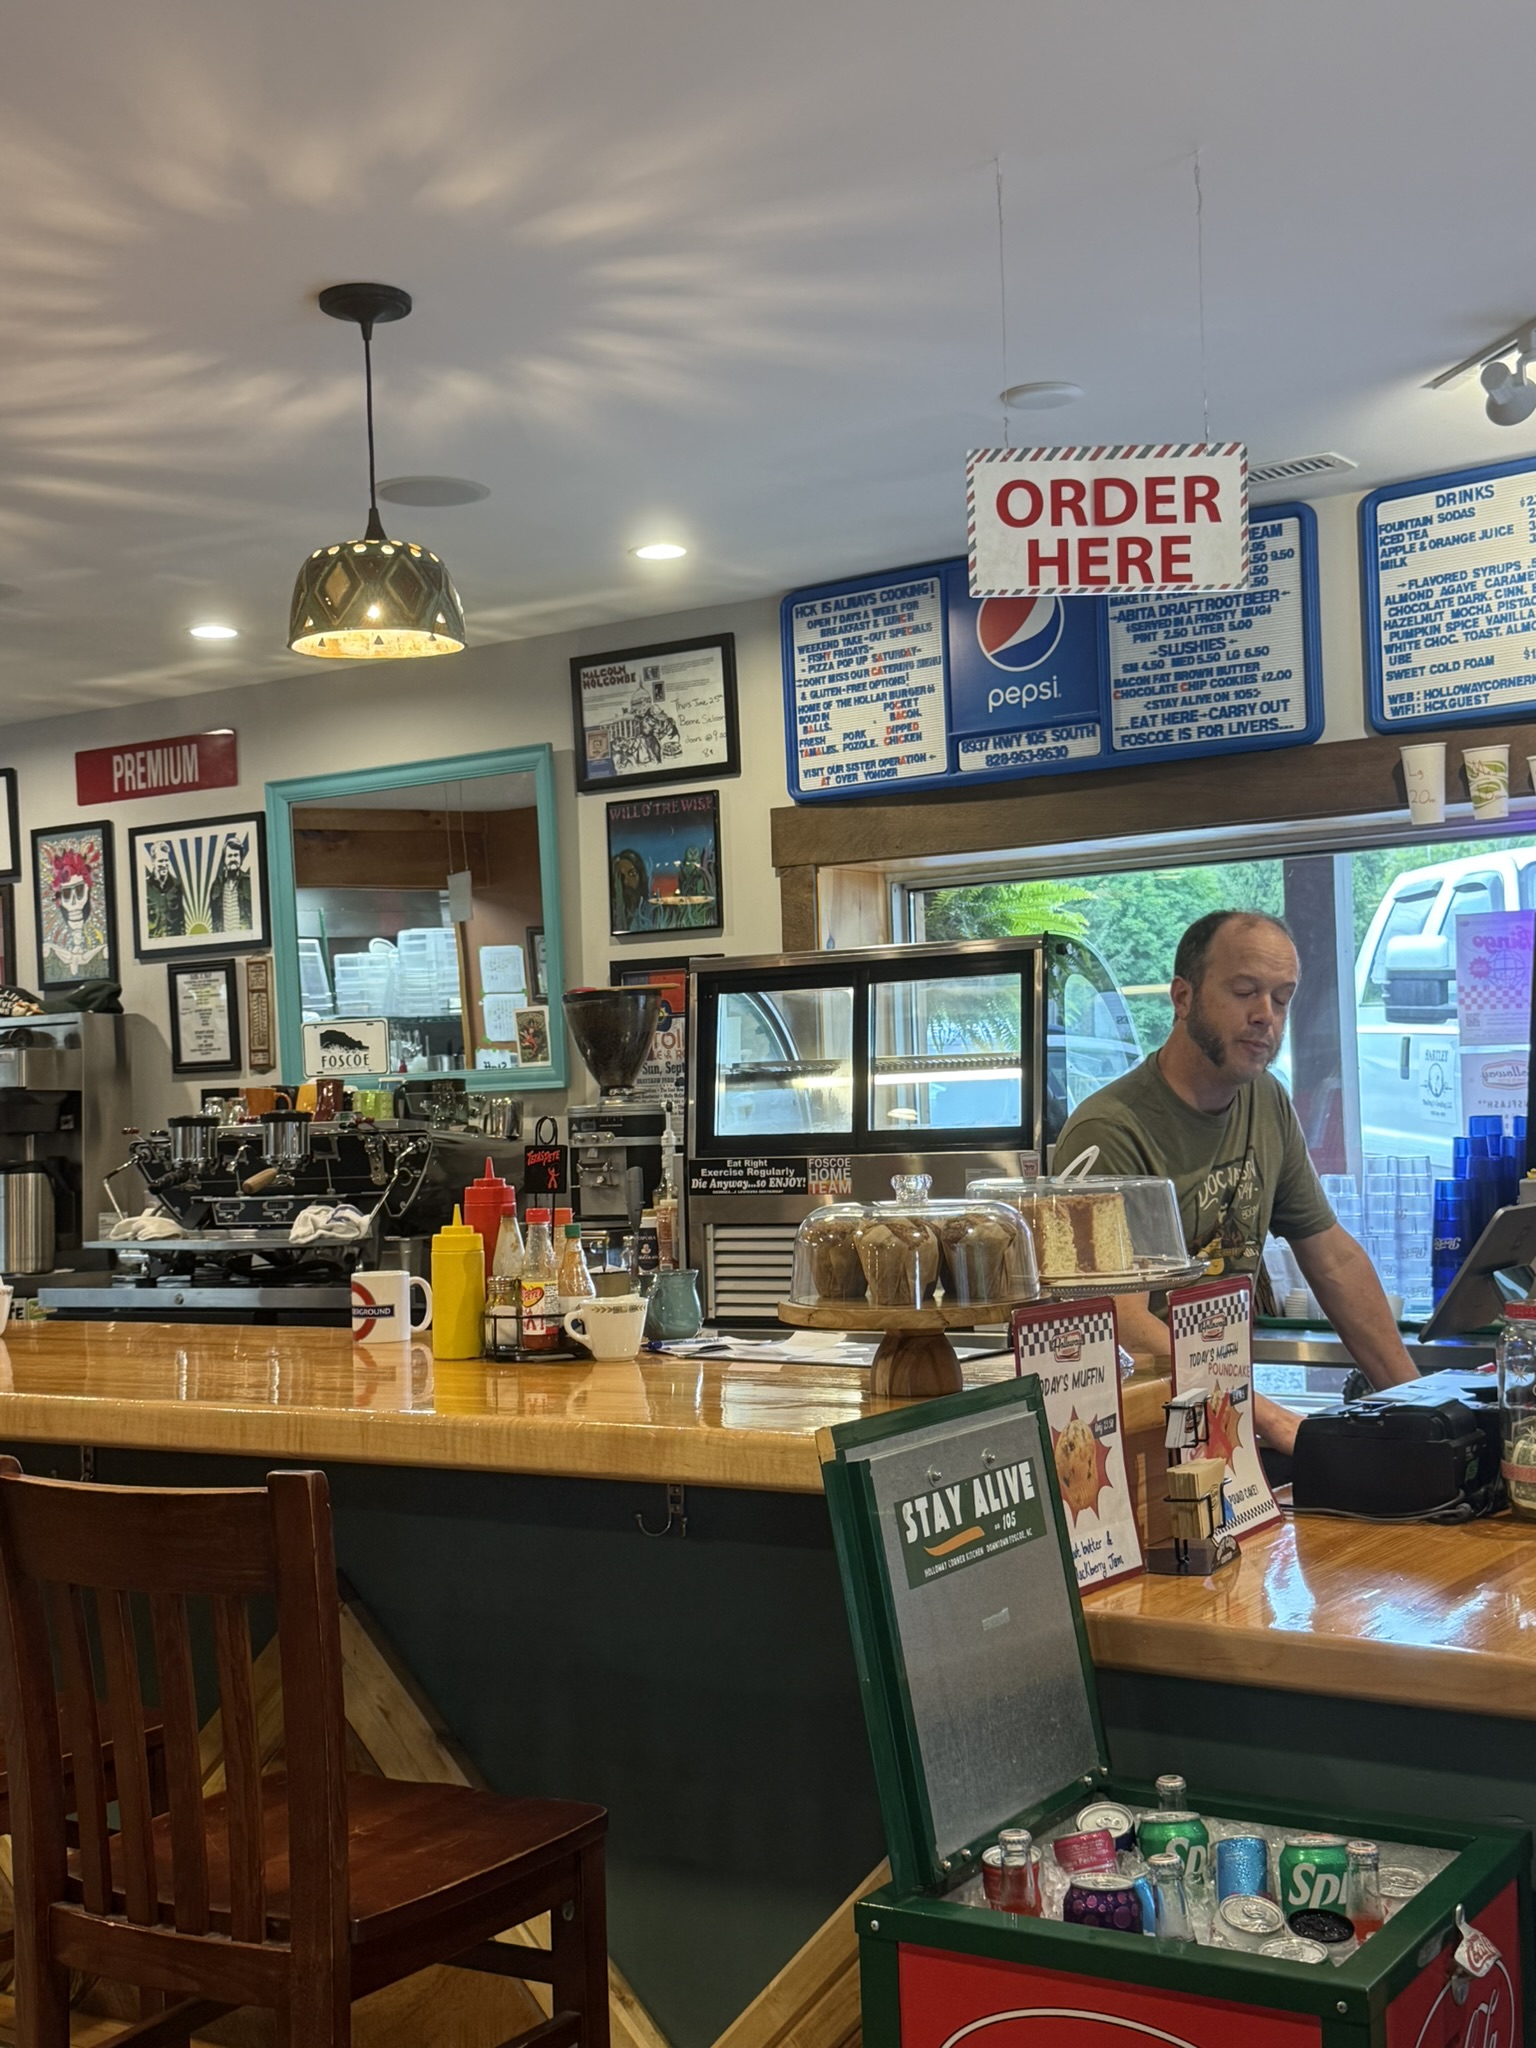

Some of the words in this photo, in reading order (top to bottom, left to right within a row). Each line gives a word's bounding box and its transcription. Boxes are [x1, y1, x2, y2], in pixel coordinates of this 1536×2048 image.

[996, 475, 1222, 529] ORDER
[1436, 485, 1495, 508] DRINKS
[1379, 516, 1433, 535] FOUNTAIN
[1438, 507, 1476, 523] SODAS
[1380, 534, 1404, 547] ICED
[1407, 529, 1429, 542] TEA
[1381, 543, 1416, 559] APPLE
[1419, 541, 1427, 551] &
[1429, 532, 1476, 550] ORANGE
[1479, 524, 1514, 541] JUICE
[1027, 535, 1193, 586] HERE
[1381, 557, 1407, 571] MILK
[1408, 571, 1468, 589] FLAVORED
[1473, 561, 1521, 578] SYRUPS
[795, 606, 817, 619] HCK
[821, 602, 831, 614] IS
[834, 593, 877, 612] ALWAYS
[880, 581, 935, 602] COOKING!
[1385, 589, 1434, 605] ALMOND
[1440, 582, 1477, 597] AGAVE
[807, 616, 830, 629] OPEN
[832, 615, 837, 626] 7
[840, 610, 861, 624] DAYS
[862, 610, 869, 620] A
[872, 604, 897, 617] WEEK
[901, 601, 919, 613] FOR
[1117, 604, 1157, 622] ABITA
[1159, 600, 1205, 617] DRAFT
[1206, 595, 1242, 611] ROOT
[1246, 589, 1279, 607] BEER
[1388, 597, 1454, 617] CHOCOLATE
[820, 621, 870, 638] BREAKFAST
[873, 619, 879, 628] &
[884, 612, 914, 626] LUNCH
[1174, 615, 1184, 626] IN
[1186, 613, 1193, 625] A
[1195, 610, 1237, 624] FROSTY
[1384, 612, 1444, 631] HAZELNUT
[1451, 604, 1492, 619] MOCHA
[797, 639, 839, 655] WEEKEND
[889, 622, 933, 639] SPECIALS
[1133, 632, 1158, 644] PINT
[1164, 628, 1188, 639] 2.50
[1193, 623, 1224, 635] LITER
[1229, 619, 1253, 630] 5.00
[1389, 625, 1440, 642] PUMPKIN
[1446, 618, 1480, 632] SPICE
[808, 651, 832, 663] FISHY
[1158, 638, 1226, 657] SLUSHIES
[1384, 640, 1421, 654] WHITE
[808, 662, 834, 674] PIZZA
[837, 657, 853, 669] POP
[856, 656, 868, 665] UP
[828, 670, 849, 684] MISS
[851, 668, 869, 680] OUR
[871, 662, 914, 676] CATERING
[917, 656, 941, 669] MENU
[1122, 663, 1138, 673] SM
[1141, 660, 1164, 671] 4.50
[1171, 657, 1195, 668] MED
[1197, 653, 1220, 664] 5.50
[1226, 650, 1240, 660] LG
[1244, 646, 1269, 658] 6.50
[1386, 666, 1426, 681] SWEET
[1429, 661, 1461, 675] COLD
[1464, 655, 1495, 669] FOAM
[1389, 653, 1412, 666] UBE
[582, 665, 626, 679] MALCOLM
[582, 673, 636, 690] HOLCOMBE
[1114, 676, 1150, 689] BACON
[1153, 673, 1171, 684] FAT
[1174, 667, 1213, 682] BROWN
[1217, 662, 1260, 678] BUTTER
[801, 691, 807, 701] &
[988, 675, 1058, 713] pepsi
[1113, 684, 1178, 700] CHOCOLATE
[1180, 680, 1207, 692] CHIP
[1210, 674, 1257, 688] COOKIES
[1181, 694, 1212, 706] ALIVE
[1213, 691, 1229, 702] ON
[798, 702, 821, 714] HOME
[823, 700, 832, 710] OF
[836, 698, 852, 708] THE
[854, 691, 888, 706] HOLLAR
[799, 712, 830, 725] BOUDIN
[883, 698, 919, 711] POCKET
[1162, 710, 1198, 726] HERE
[1208, 703, 1257, 720] CARRY
[1260, 699, 1290, 715] OUT
[799, 736, 826, 748] FRESH
[843, 730, 866, 741] PORK
[886, 722, 919, 735] DIPPED
[883, 732, 922, 746] CHICKEN
[961, 739, 989, 753] 8937
[993, 734, 1022, 751] HWY
[1025, 731, 1047, 746] 105
[1051, 725, 1096, 742] SOUTH
[1121, 730, 1174, 747] FOSCOE
[1179, 728, 1191, 740] IS
[1197, 724, 1224, 739] FOR
[112, 743, 199, 793] PREMIUM
[803, 767, 825, 778] VISIT
[827, 763, 844, 775] OUR
[846, 759, 876, 771] SISTER
[878, 752, 926, 767] OPERATION
[1407, 761, 1423, 780] Lg
[821, 777, 830, 786] AT
[836, 774, 858, 784] OVER
[864, 768, 897, 781] YONDER
[609, 805, 640, 821] WILL
[321, 1054, 370, 1068] FOSCOE
[642, 1062, 662, 1075] Sun,
[727, 1160, 741, 1168] Eat
[744, 1159, 767, 1168] Right
[747, 1168, 795, 1177] Regularly
[808, 1158, 850, 1168] FOSCOE
[808, 1168, 850, 1180] HOME
[692, 1179, 707, 1189] Die
[769, 1177, 806, 1188] ENJOY!
[811, 1182, 851, 1194] TEAM
[1189, 1349, 1214, 1369] TODAY'S
[1208, 1363, 1250, 1378] POUNDCAKE
[1040, 1374, 1068, 1396] ODAY'S
[1072, 1366, 1105, 1390] MUFFIN
[902, 1484, 963, 1544] STAY
[972, 1460, 1036, 1519] ALIVE
[1228, 1490, 1244, 1505] POUND
[1002, 1511, 1016, 1530] 105
[924, 1562, 948, 1578] HOLLOWAY
[948, 1555, 966, 1568] CORNER
[966, 1547, 984, 1560] KITCHEN
[986, 1540, 1009, 1552] DOWNTOWN
[1026, 1528, 1032, 1536] NC
[1081, 1537, 1102, 1555] butter
[1108, 1553, 1124, 1570] Jam
